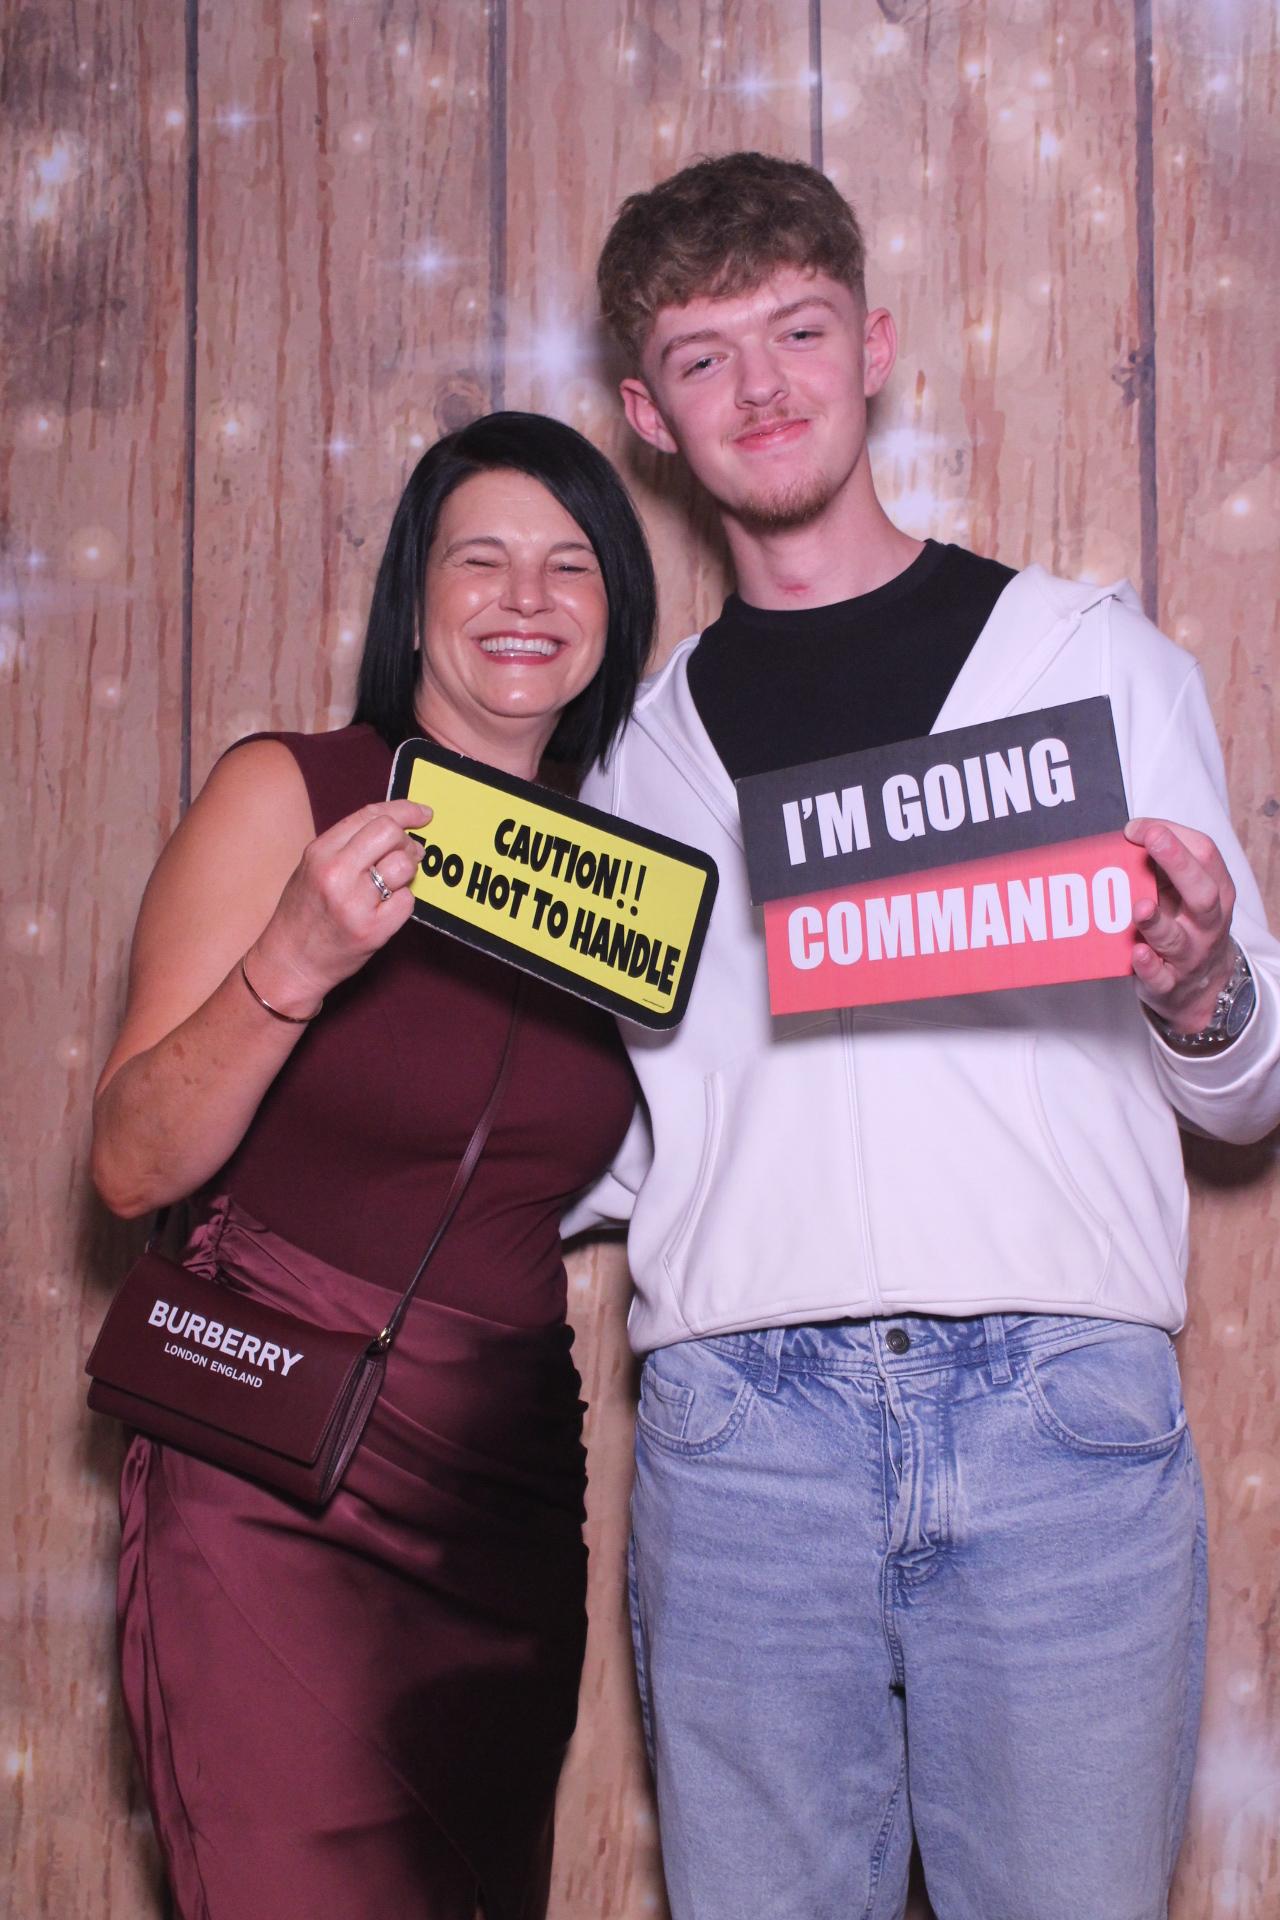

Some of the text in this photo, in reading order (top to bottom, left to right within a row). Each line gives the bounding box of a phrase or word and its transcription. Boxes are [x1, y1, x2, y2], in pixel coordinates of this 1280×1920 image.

[782, 737, 1076, 866] I'M GOING
[494, 818, 647, 916] CAUTION!!
[466, 861, 530, 919] HOT
[531, 887, 569, 939] TO
[569, 907, 681, 996] HANDLE
[787, 866, 1132, 970] COMMANDO
[148, 1300, 304, 1376] BURBERRY
[164, 1342, 263, 1388] LONDON ENGLAND
